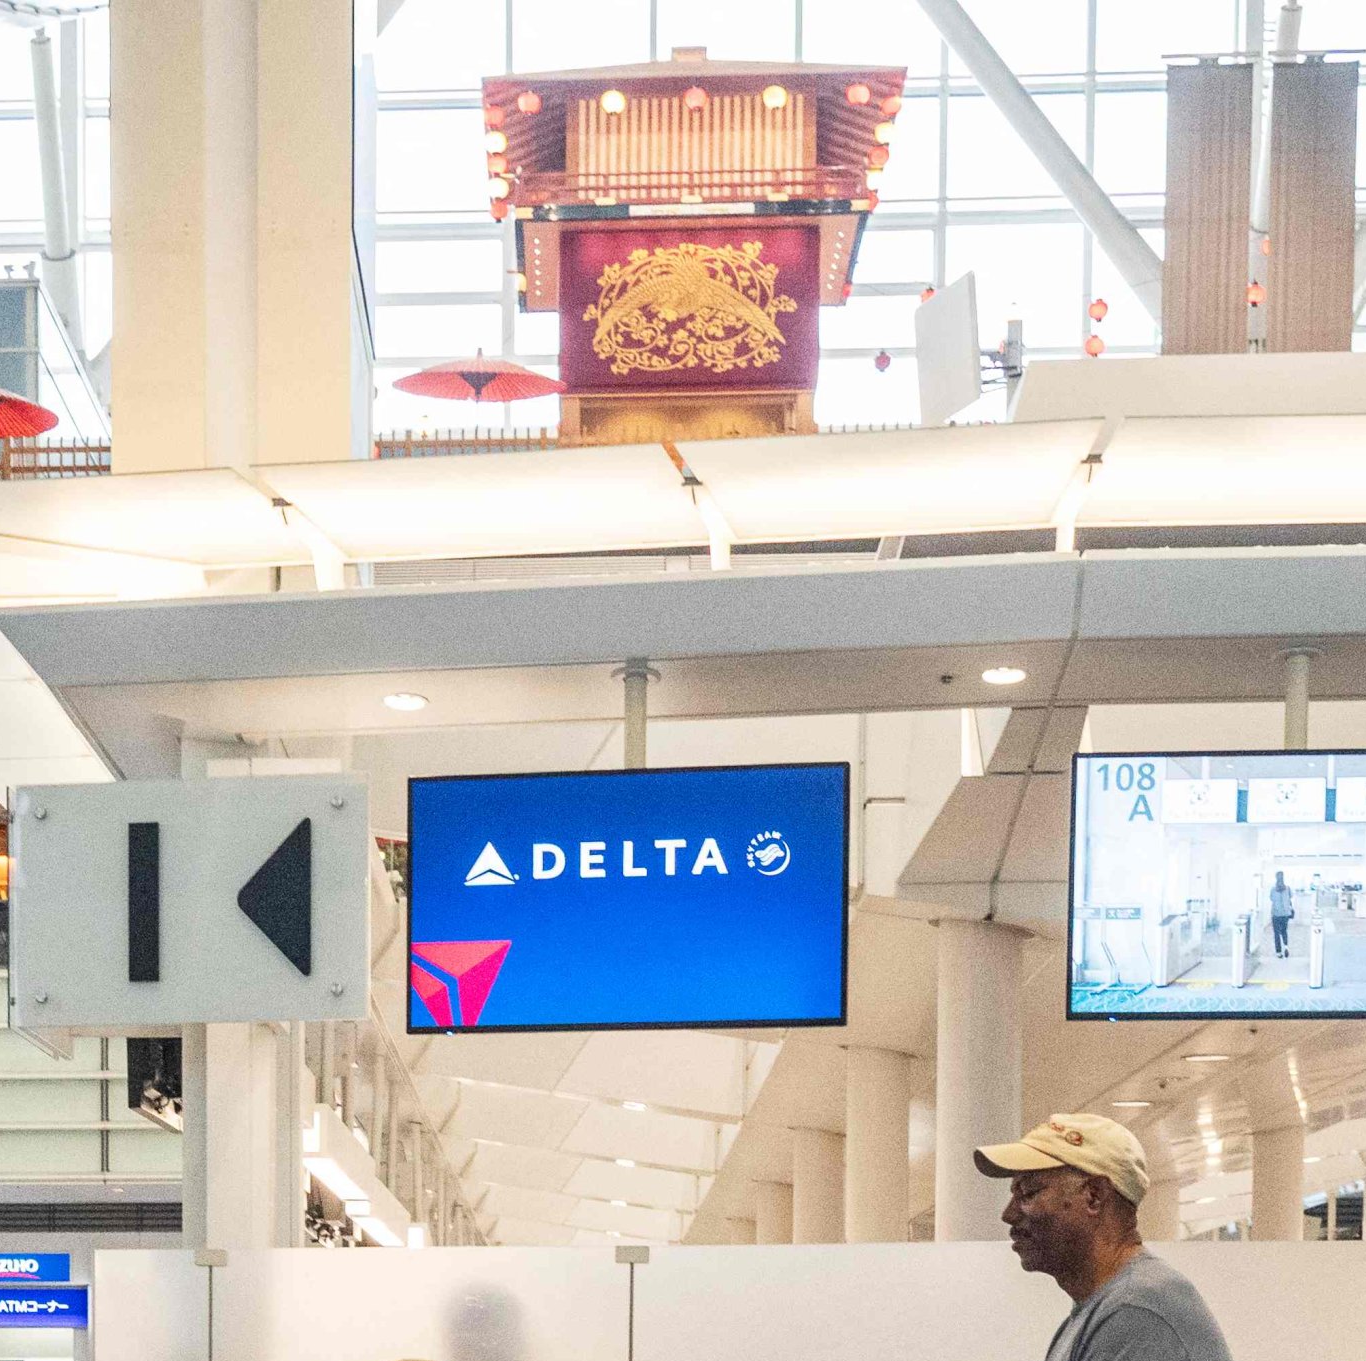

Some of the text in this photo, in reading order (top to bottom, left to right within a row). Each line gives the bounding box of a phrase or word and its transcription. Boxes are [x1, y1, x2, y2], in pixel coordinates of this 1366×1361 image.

[1096, 762, 1157, 792] 108
[1128, 794, 1154, 822] A
[532, 838, 729, 880] DELTA
